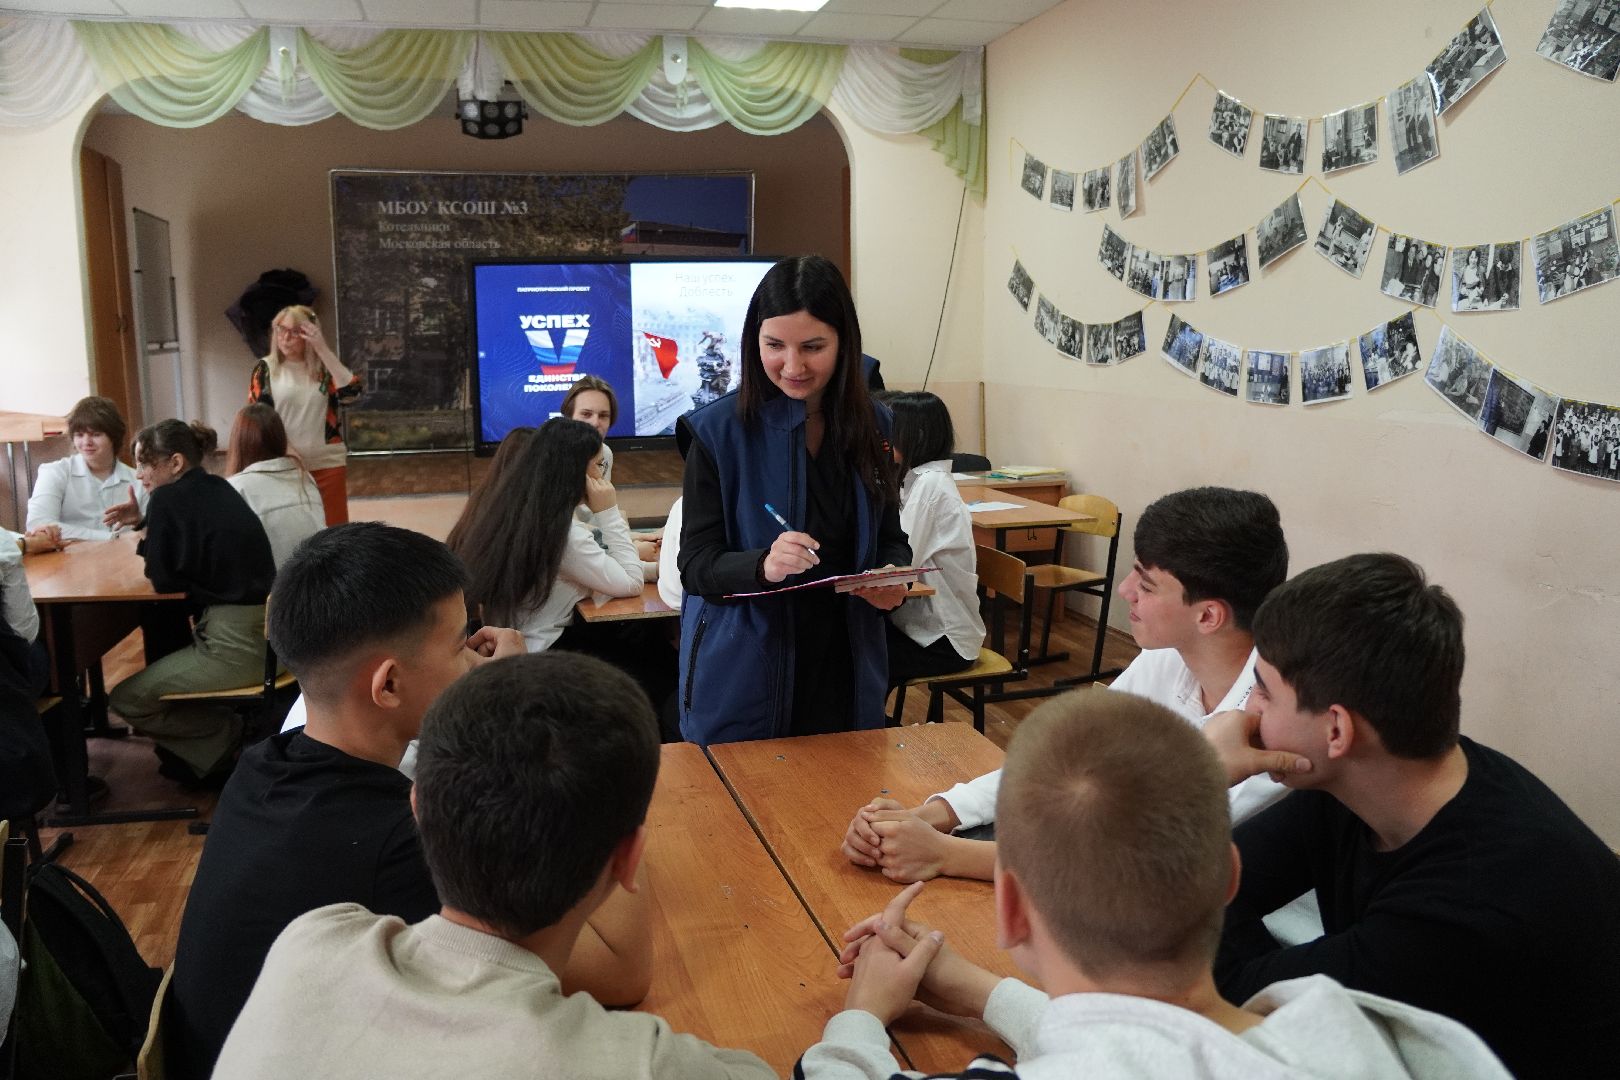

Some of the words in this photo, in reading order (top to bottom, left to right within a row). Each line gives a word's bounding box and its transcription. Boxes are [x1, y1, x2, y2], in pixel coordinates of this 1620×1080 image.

[378, 200, 432, 215] МБОУ
[438, 200, 496, 215] КСОШ
[500, 200, 529, 215] №3
[378, 221, 450, 233] Котельники
[378, 238, 451, 249] Московская
[454, 238, 501, 249] область
[676, 272, 700, 283] Наш
[519, 314, 591, 329] УСПЕХ
